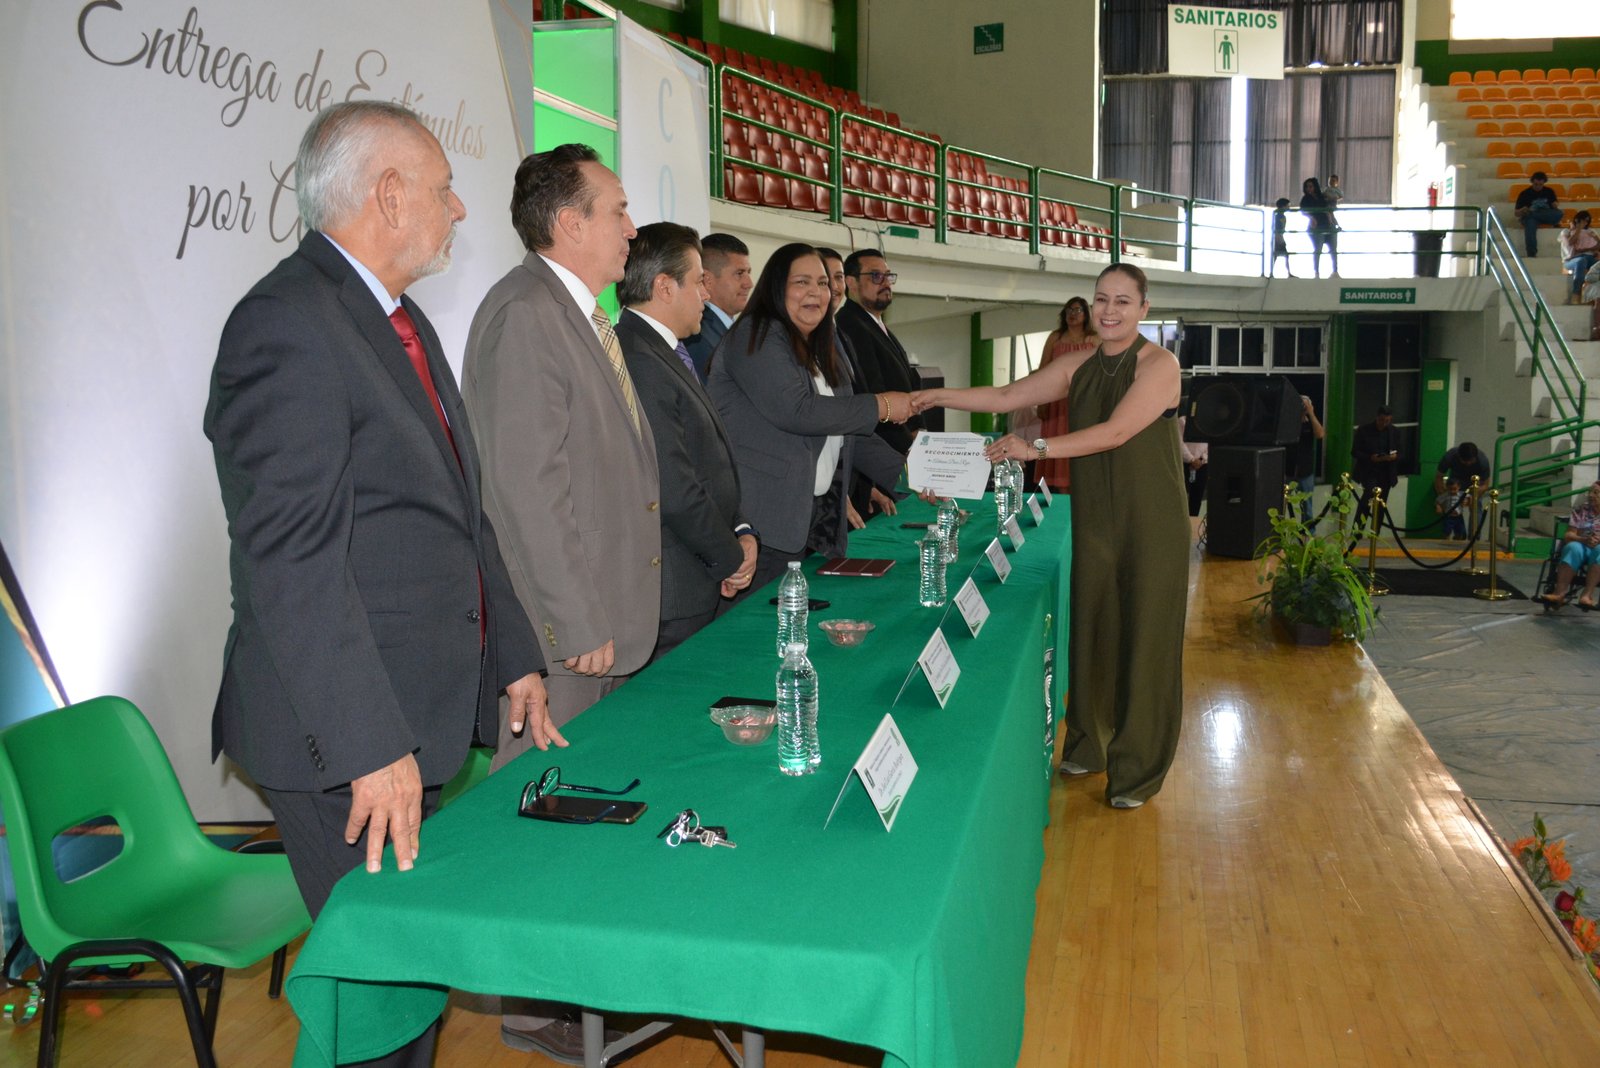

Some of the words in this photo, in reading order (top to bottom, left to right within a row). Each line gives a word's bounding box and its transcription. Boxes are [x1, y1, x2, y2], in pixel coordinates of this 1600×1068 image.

[1174, 8, 1278, 29] SANITARIOS
[78, 0, 282, 127] Entrega
[295, 48, 334, 113] de
[176, 180, 256, 260] por
[1345, 291, 1403, 300] SANITARIOS
